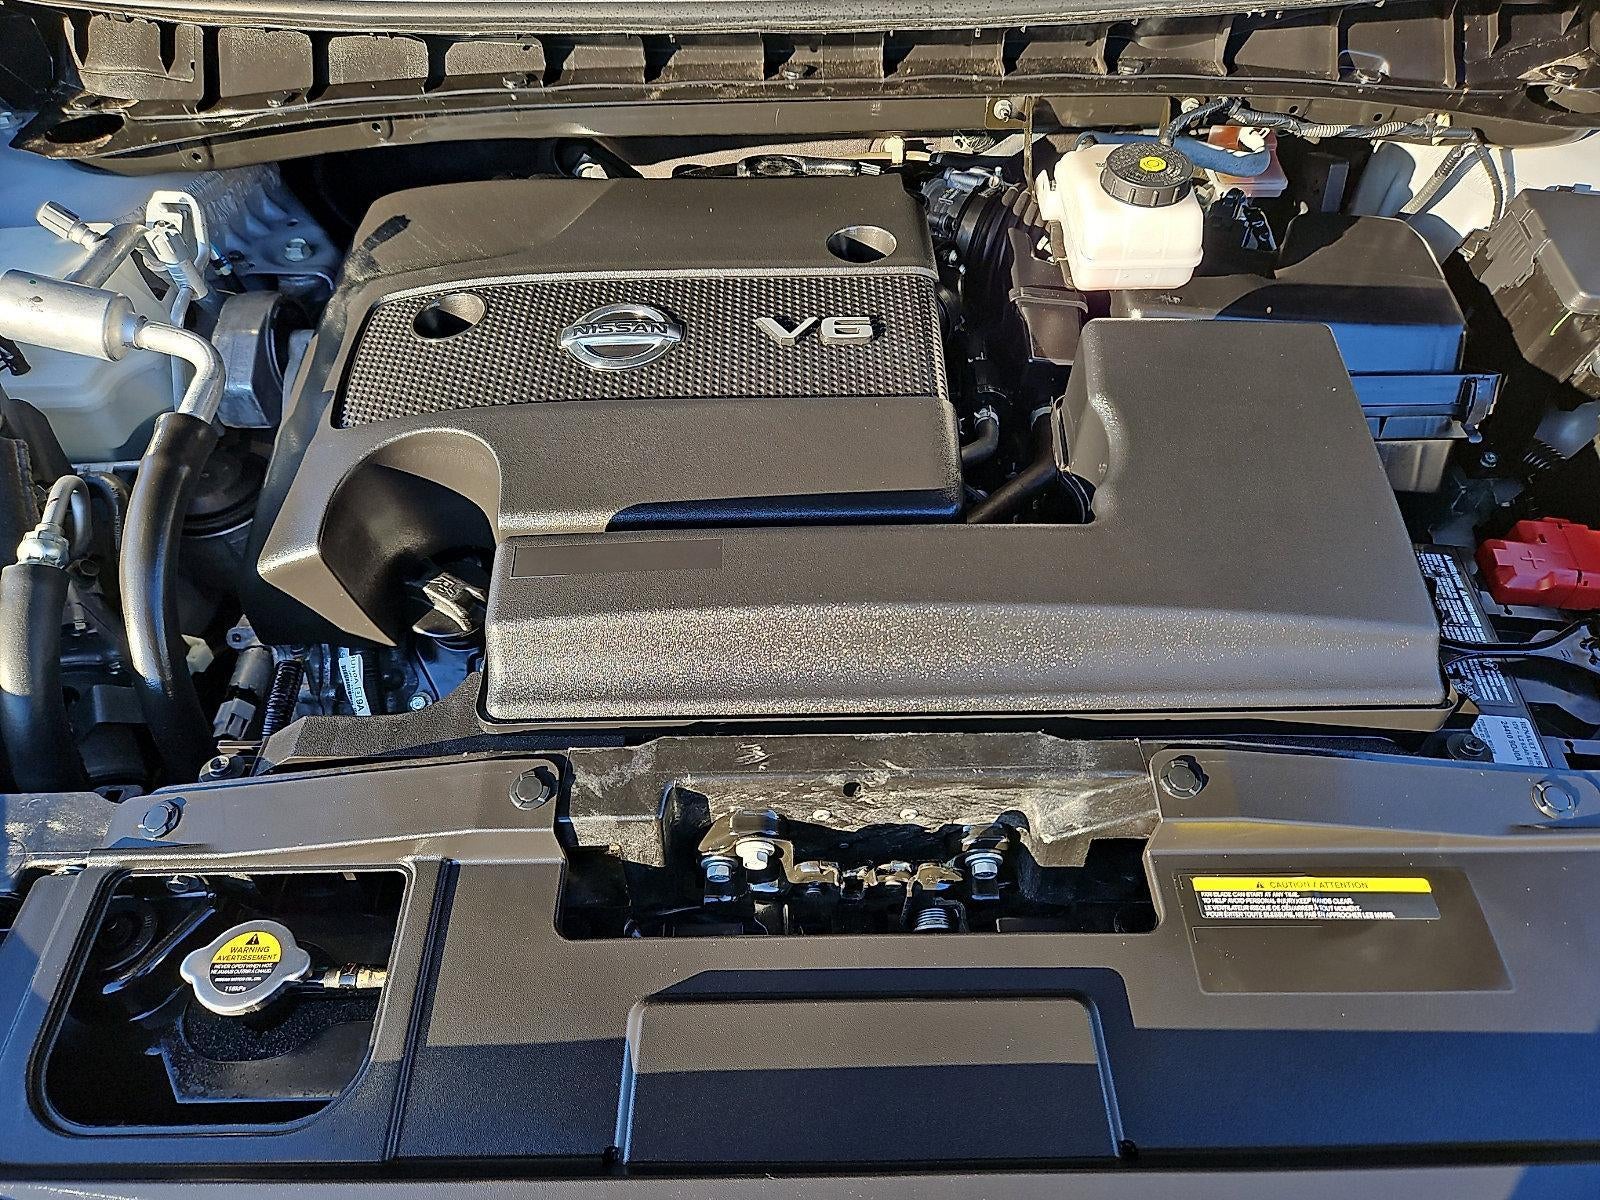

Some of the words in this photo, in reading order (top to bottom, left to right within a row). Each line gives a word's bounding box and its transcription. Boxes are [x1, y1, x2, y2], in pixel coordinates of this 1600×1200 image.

[573, 321, 668, 335] NISSAN
[755, 316, 873, 347] V6
[1269, 881, 1310, 889] CAUTION
[1319, 881, 1369, 889] ATTENTION
